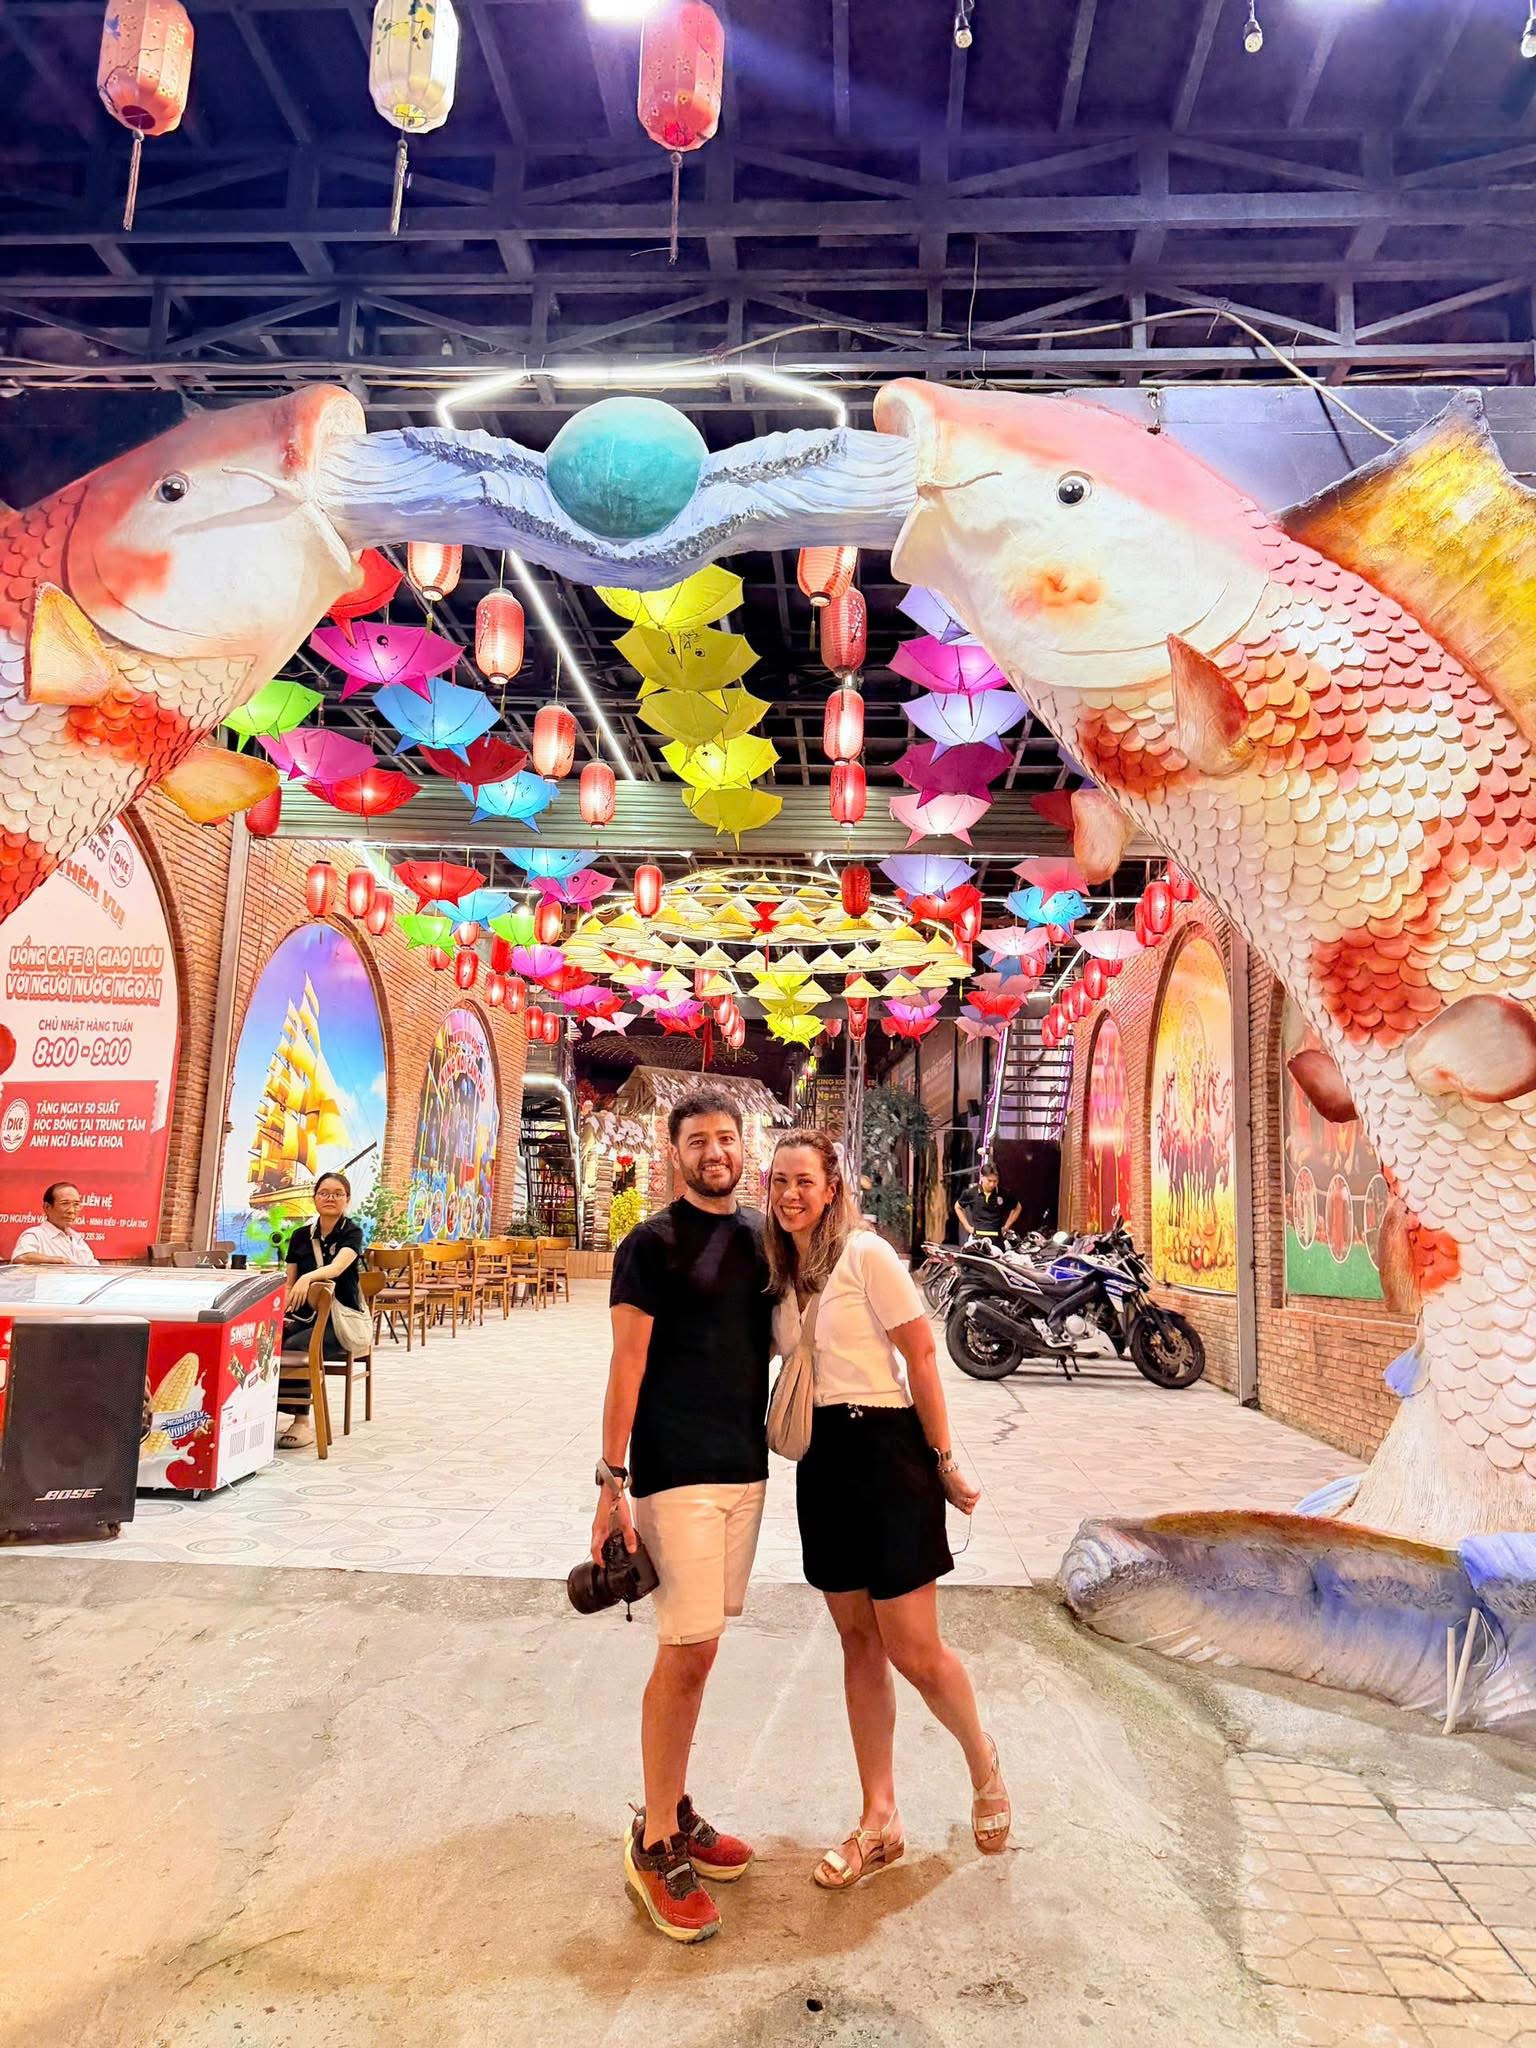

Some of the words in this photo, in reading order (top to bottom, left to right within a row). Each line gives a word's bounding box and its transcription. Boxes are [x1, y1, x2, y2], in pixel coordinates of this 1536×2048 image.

[102, 889, 126, 928] VUI
[10, 936, 46, 969] UỐNG
[47, 946, 84, 970] CAFE
[84, 947, 94, 970] &
[96, 946, 131, 971] GIAO
[132, 944, 164, 971] LƯU
[6, 970, 30, 996] VỚI
[30, 973, 72, 999] NGƯỜI
[73, 972, 112, 1001] NƯỚC
[113, 975, 162, 1004] NGOÀI
[39, 1016, 58, 1031] CHỦ
[60, 1017, 85, 1034] NHẬT
[86, 1018, 110, 1032] HÀNG
[33, 1037, 79, 1067] 8:00
[91, 1037, 132, 1066] 9:00
[37, 1100, 59, 1115] TẶNG
[60, 1102, 85, 1115] NGAY
[85, 1102, 96, 1114] 50
[97, 1099, 120, 1114] SUẤT
[7, 1118, 23, 1131] DKE
[33, 1118, 51, 1134] HỌC
[80, 1118, 94, 1133] TẠI
[95, 1119, 125, 1131] TRUNG
[127, 1117, 146, 1131] TÂM
[30, 1135, 49, 1147] ANH
[50, 1132, 70, 1147] NGỮ
[70, 1133, 96, 1147] ĐĂNG
[97, 1136, 123, 1148] KHOA
[101, 1194, 113, 1210] HỆ
[34, 1488, 103, 1501] BOSE
